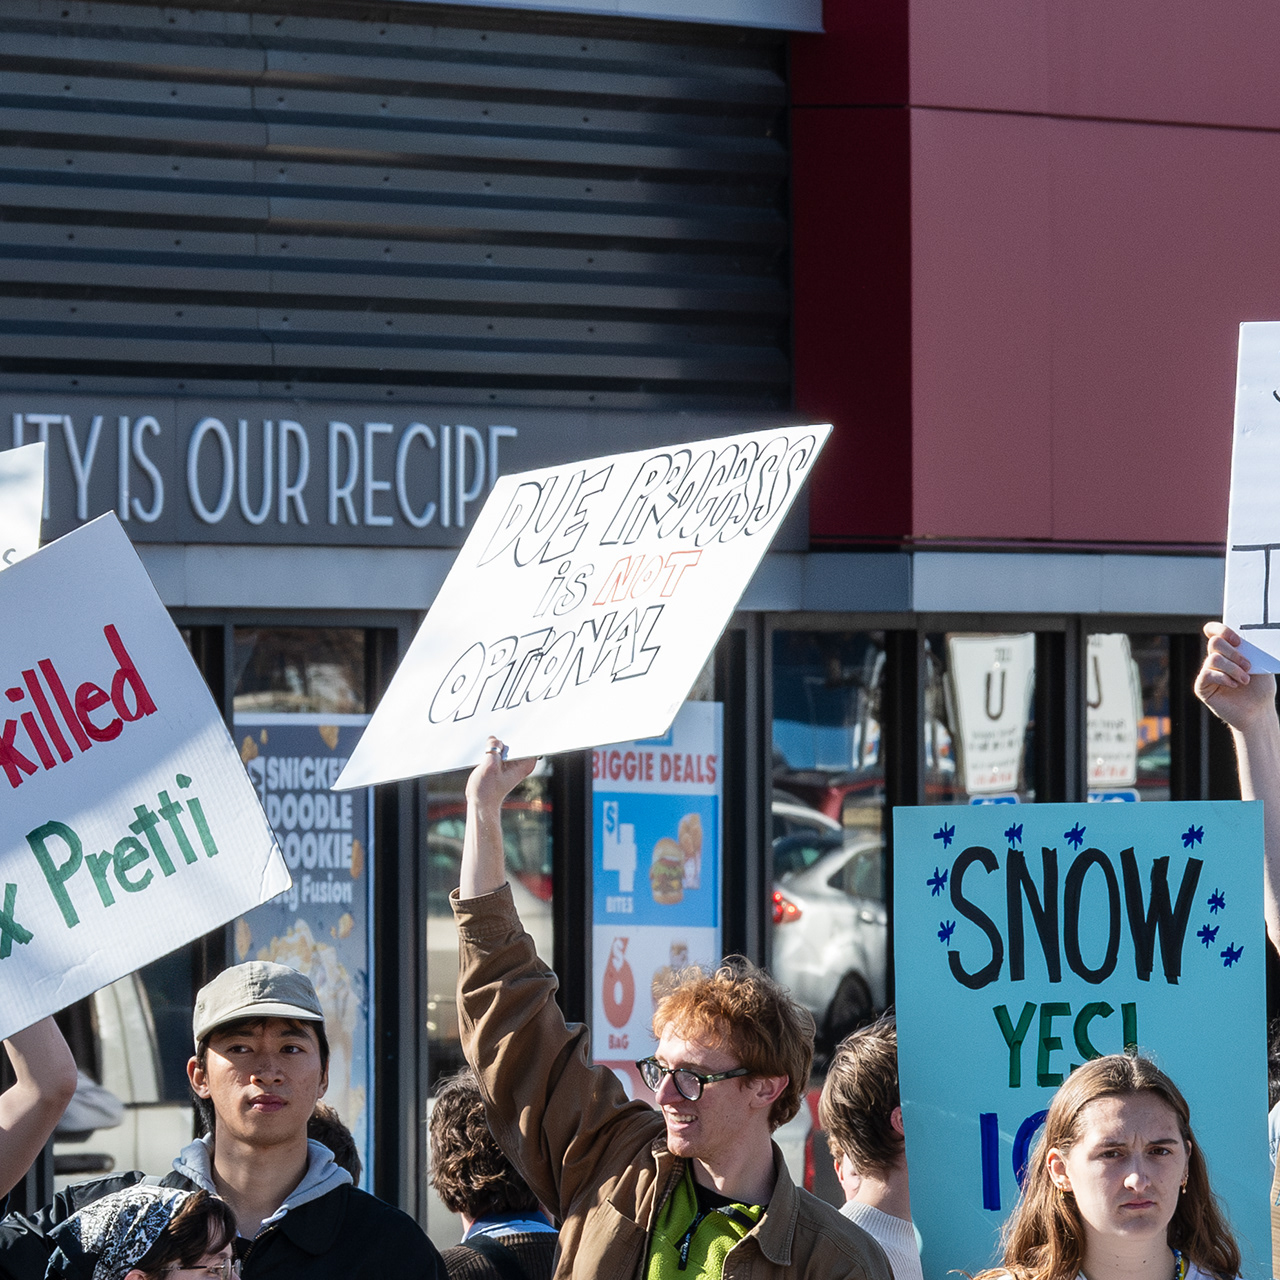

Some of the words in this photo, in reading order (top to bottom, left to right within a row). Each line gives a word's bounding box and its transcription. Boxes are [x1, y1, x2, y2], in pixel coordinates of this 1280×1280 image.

[118, 415, 165, 523] IS
[187, 417, 310, 525] OUR
[477, 463, 615, 568] DUE
[533, 561, 595, 619] is
[592, 549, 702, 606] NOT
[428, 604, 665, 724] OPTIONAL
[266, 756, 350, 791] SNICKE
[266, 792, 353, 830] DOODLE
[592, 750, 655, 782] BIGGIE
[660, 752, 718, 785] DEALS
[25, 773, 220, 930] Pretti
[302, 872, 354, 903] Fusion
[948, 846, 1204, 990] SNOW
